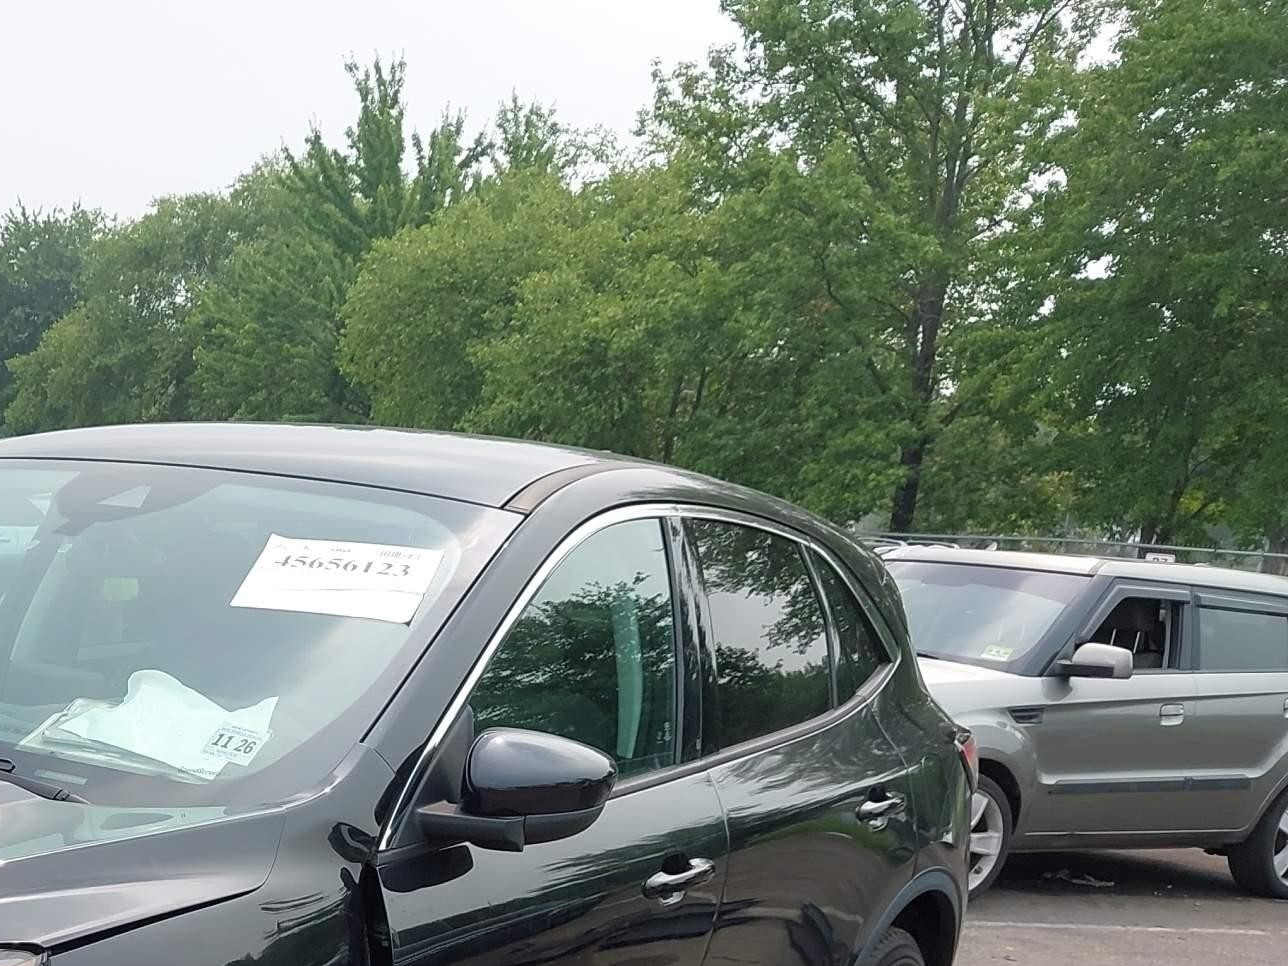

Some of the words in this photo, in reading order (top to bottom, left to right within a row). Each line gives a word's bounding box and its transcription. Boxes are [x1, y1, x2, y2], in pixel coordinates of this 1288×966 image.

[274, 554, 412, 577] 45656123
[211, 733, 234, 749] 11
[233, 738, 257, 754] 26
